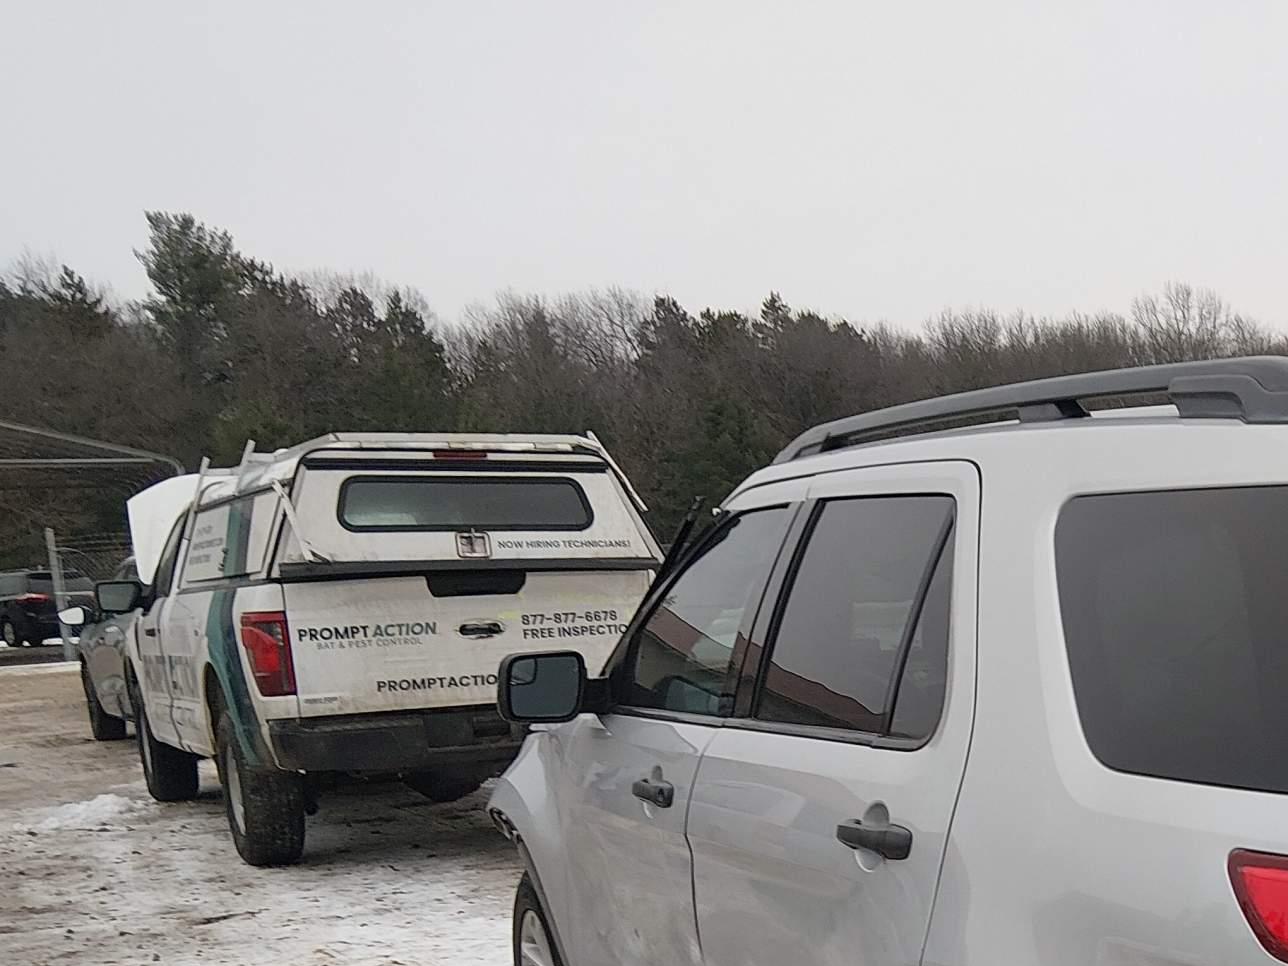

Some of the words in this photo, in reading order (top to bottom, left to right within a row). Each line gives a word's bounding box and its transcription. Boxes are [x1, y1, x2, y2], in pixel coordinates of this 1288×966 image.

[497, 540, 523, 549] NOW
[526, 540, 560, 549] HIRING
[562, 539, 631, 549] TECHNICIANS!
[521, 610, 618, 626] 877-877-6678
[297, 625, 369, 642] PROMPT
[372, 621, 438, 638] ACTION
[523, 627, 555, 640] FREE
[317, 642, 335, 650] BAT
[339, 641, 346, 649] &
[349, 639, 373, 649] PEST
[376, 636, 423, 646] CONTROL
